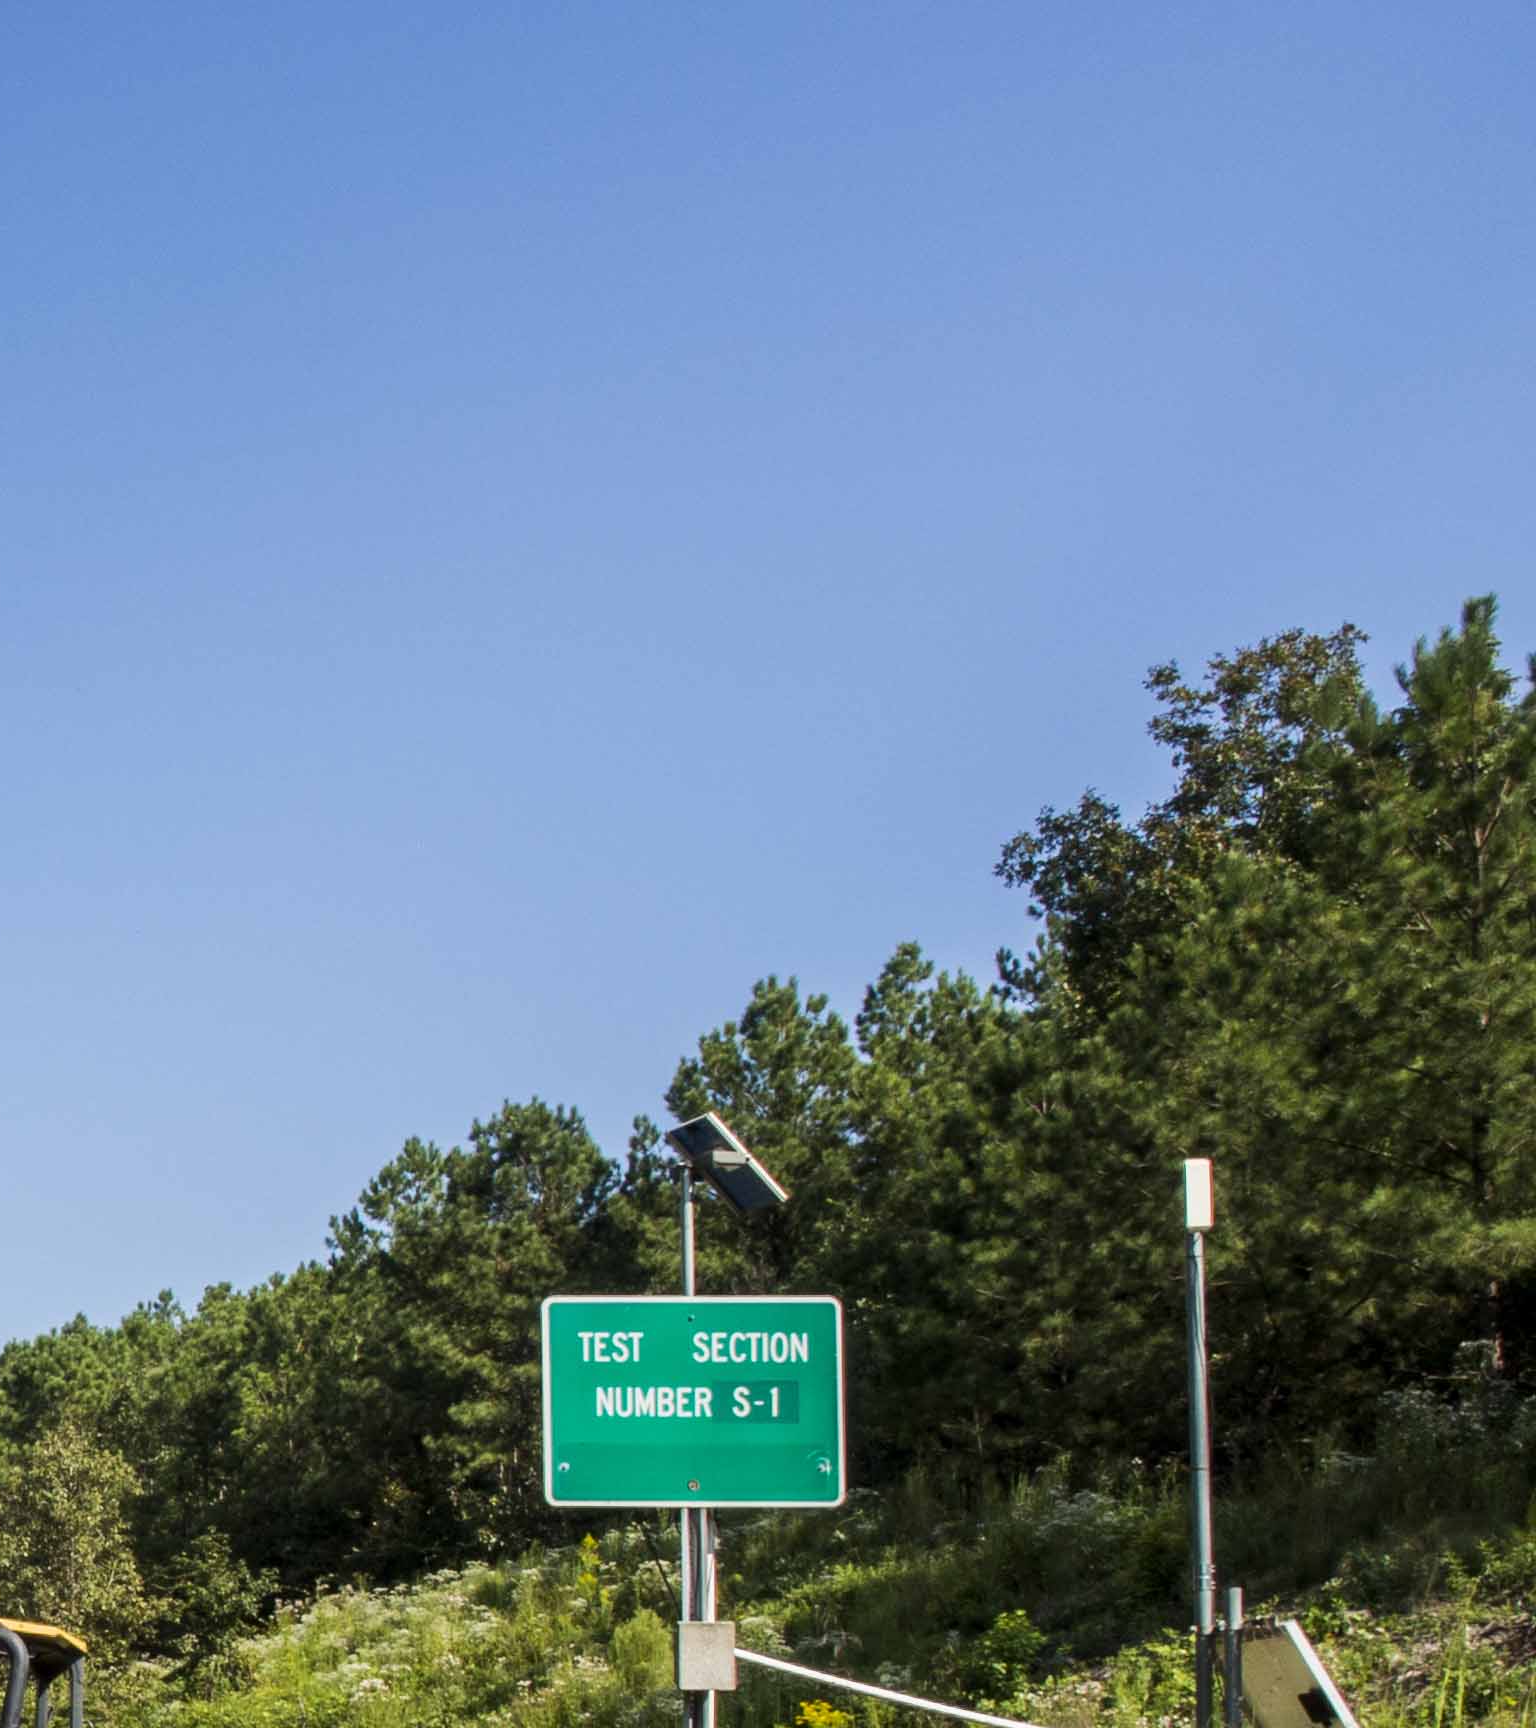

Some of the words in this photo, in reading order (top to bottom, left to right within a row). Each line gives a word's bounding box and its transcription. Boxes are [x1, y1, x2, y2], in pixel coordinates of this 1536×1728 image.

[577, 1331, 644, 1363] TEST
[692, 1331, 809, 1364] SECTION
[595, 1386, 713, 1418] NUMBER
[732, 1386, 780, 1418] S-1
